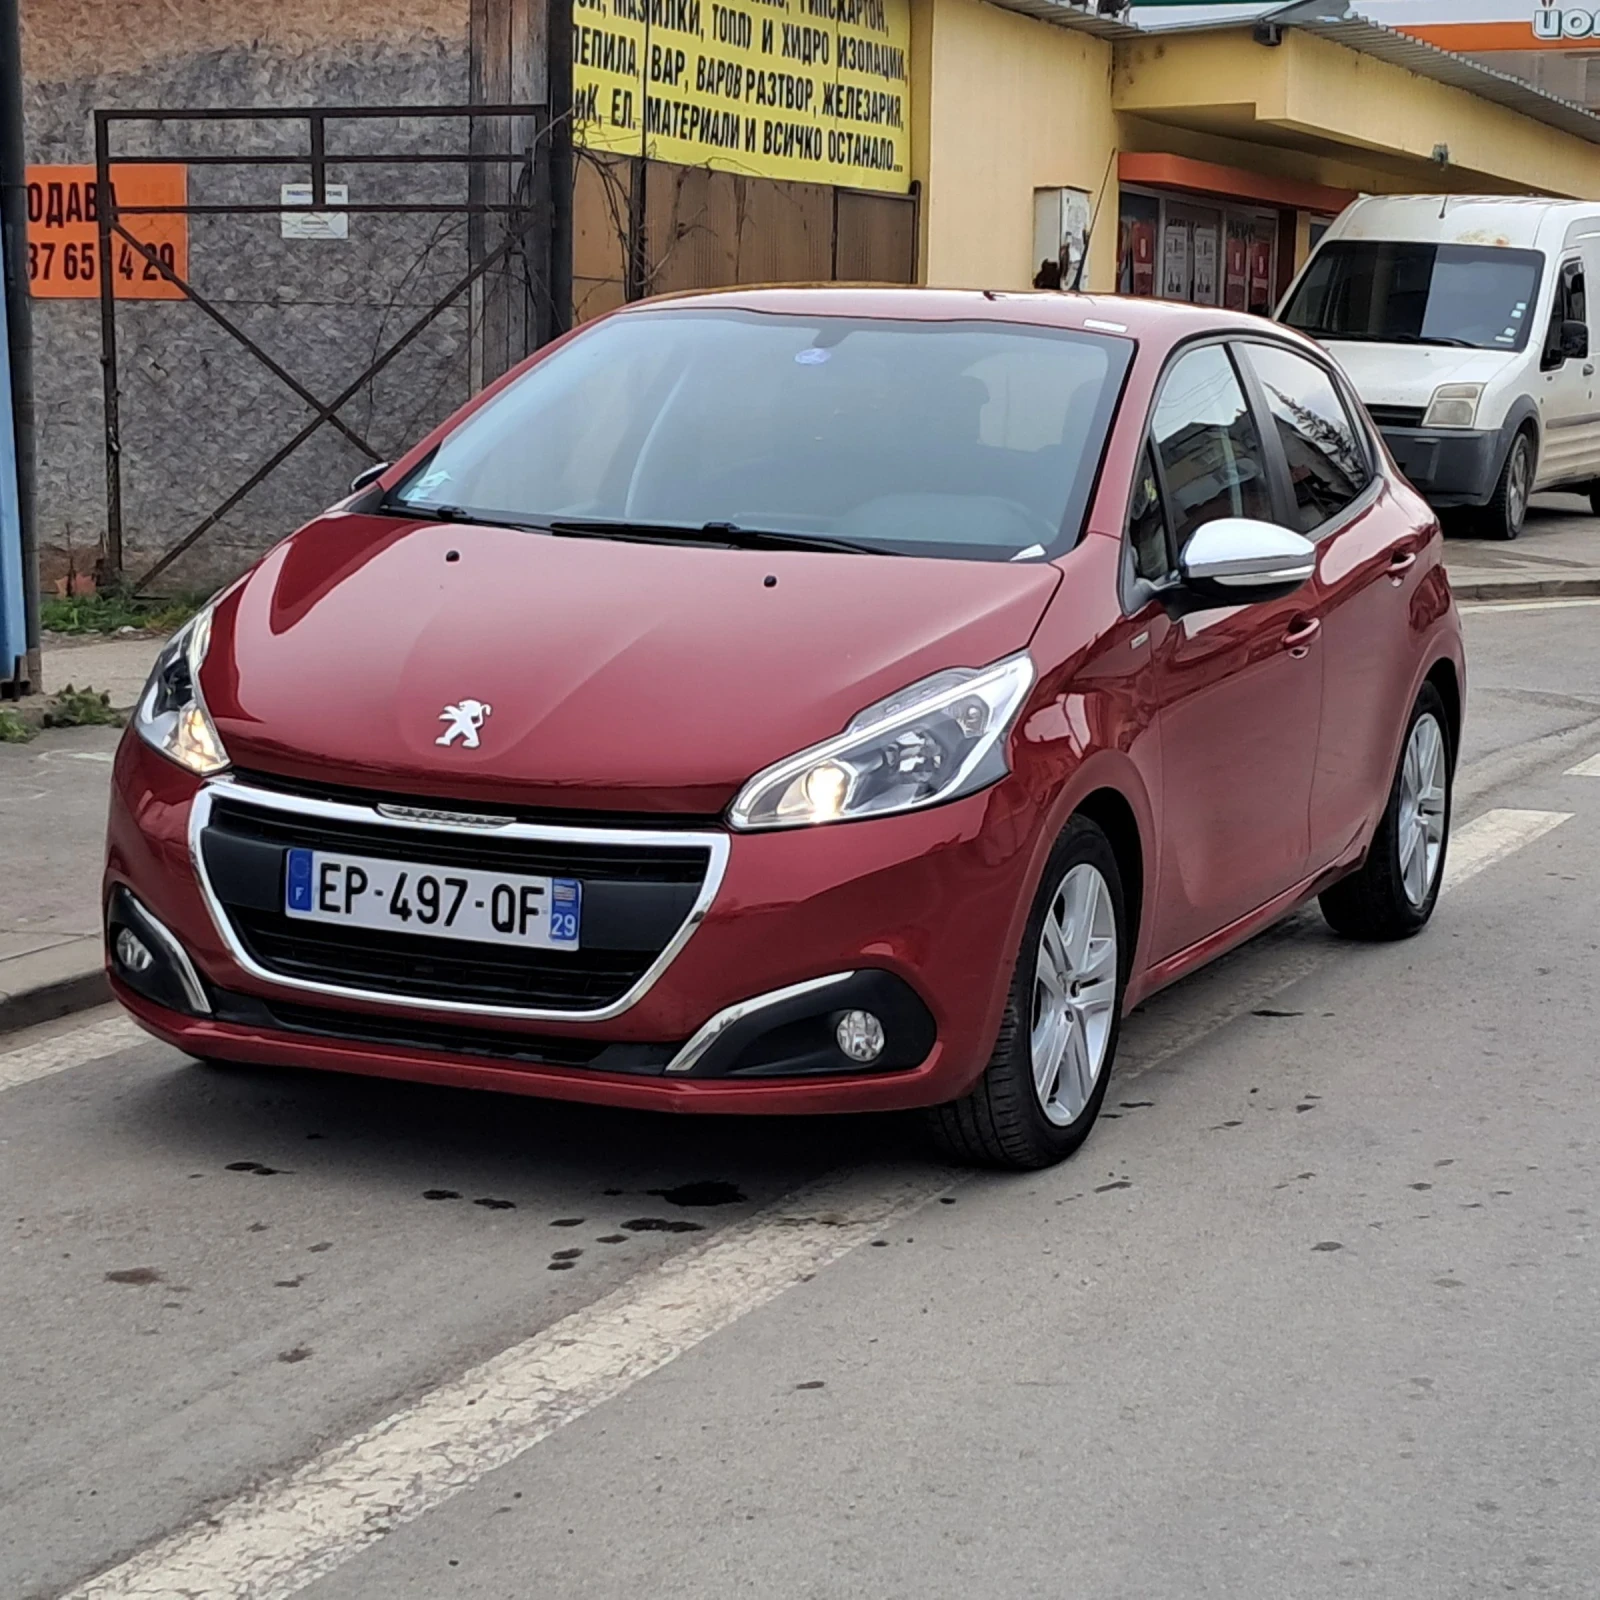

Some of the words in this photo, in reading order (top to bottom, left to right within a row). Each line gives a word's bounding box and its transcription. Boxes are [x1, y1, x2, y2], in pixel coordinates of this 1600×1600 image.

[761, 18, 773, 55] И
[781, 22, 829, 67] ХИДРО
[611, 88, 636, 131] ЕЛ.
[648, 96, 740, 150] МАТЕРИАЛИ
[745, 118, 756, 153] И
[763, 120, 822, 161] ВСИЧКО
[696, 55, 742, 100] ВАРОВ
[822, 82, 904, 132] ЖЕЛЕЗАРИЯ,
[319, 862, 545, 935] EP-497-QF
[551, 912, 577, 937] 29
